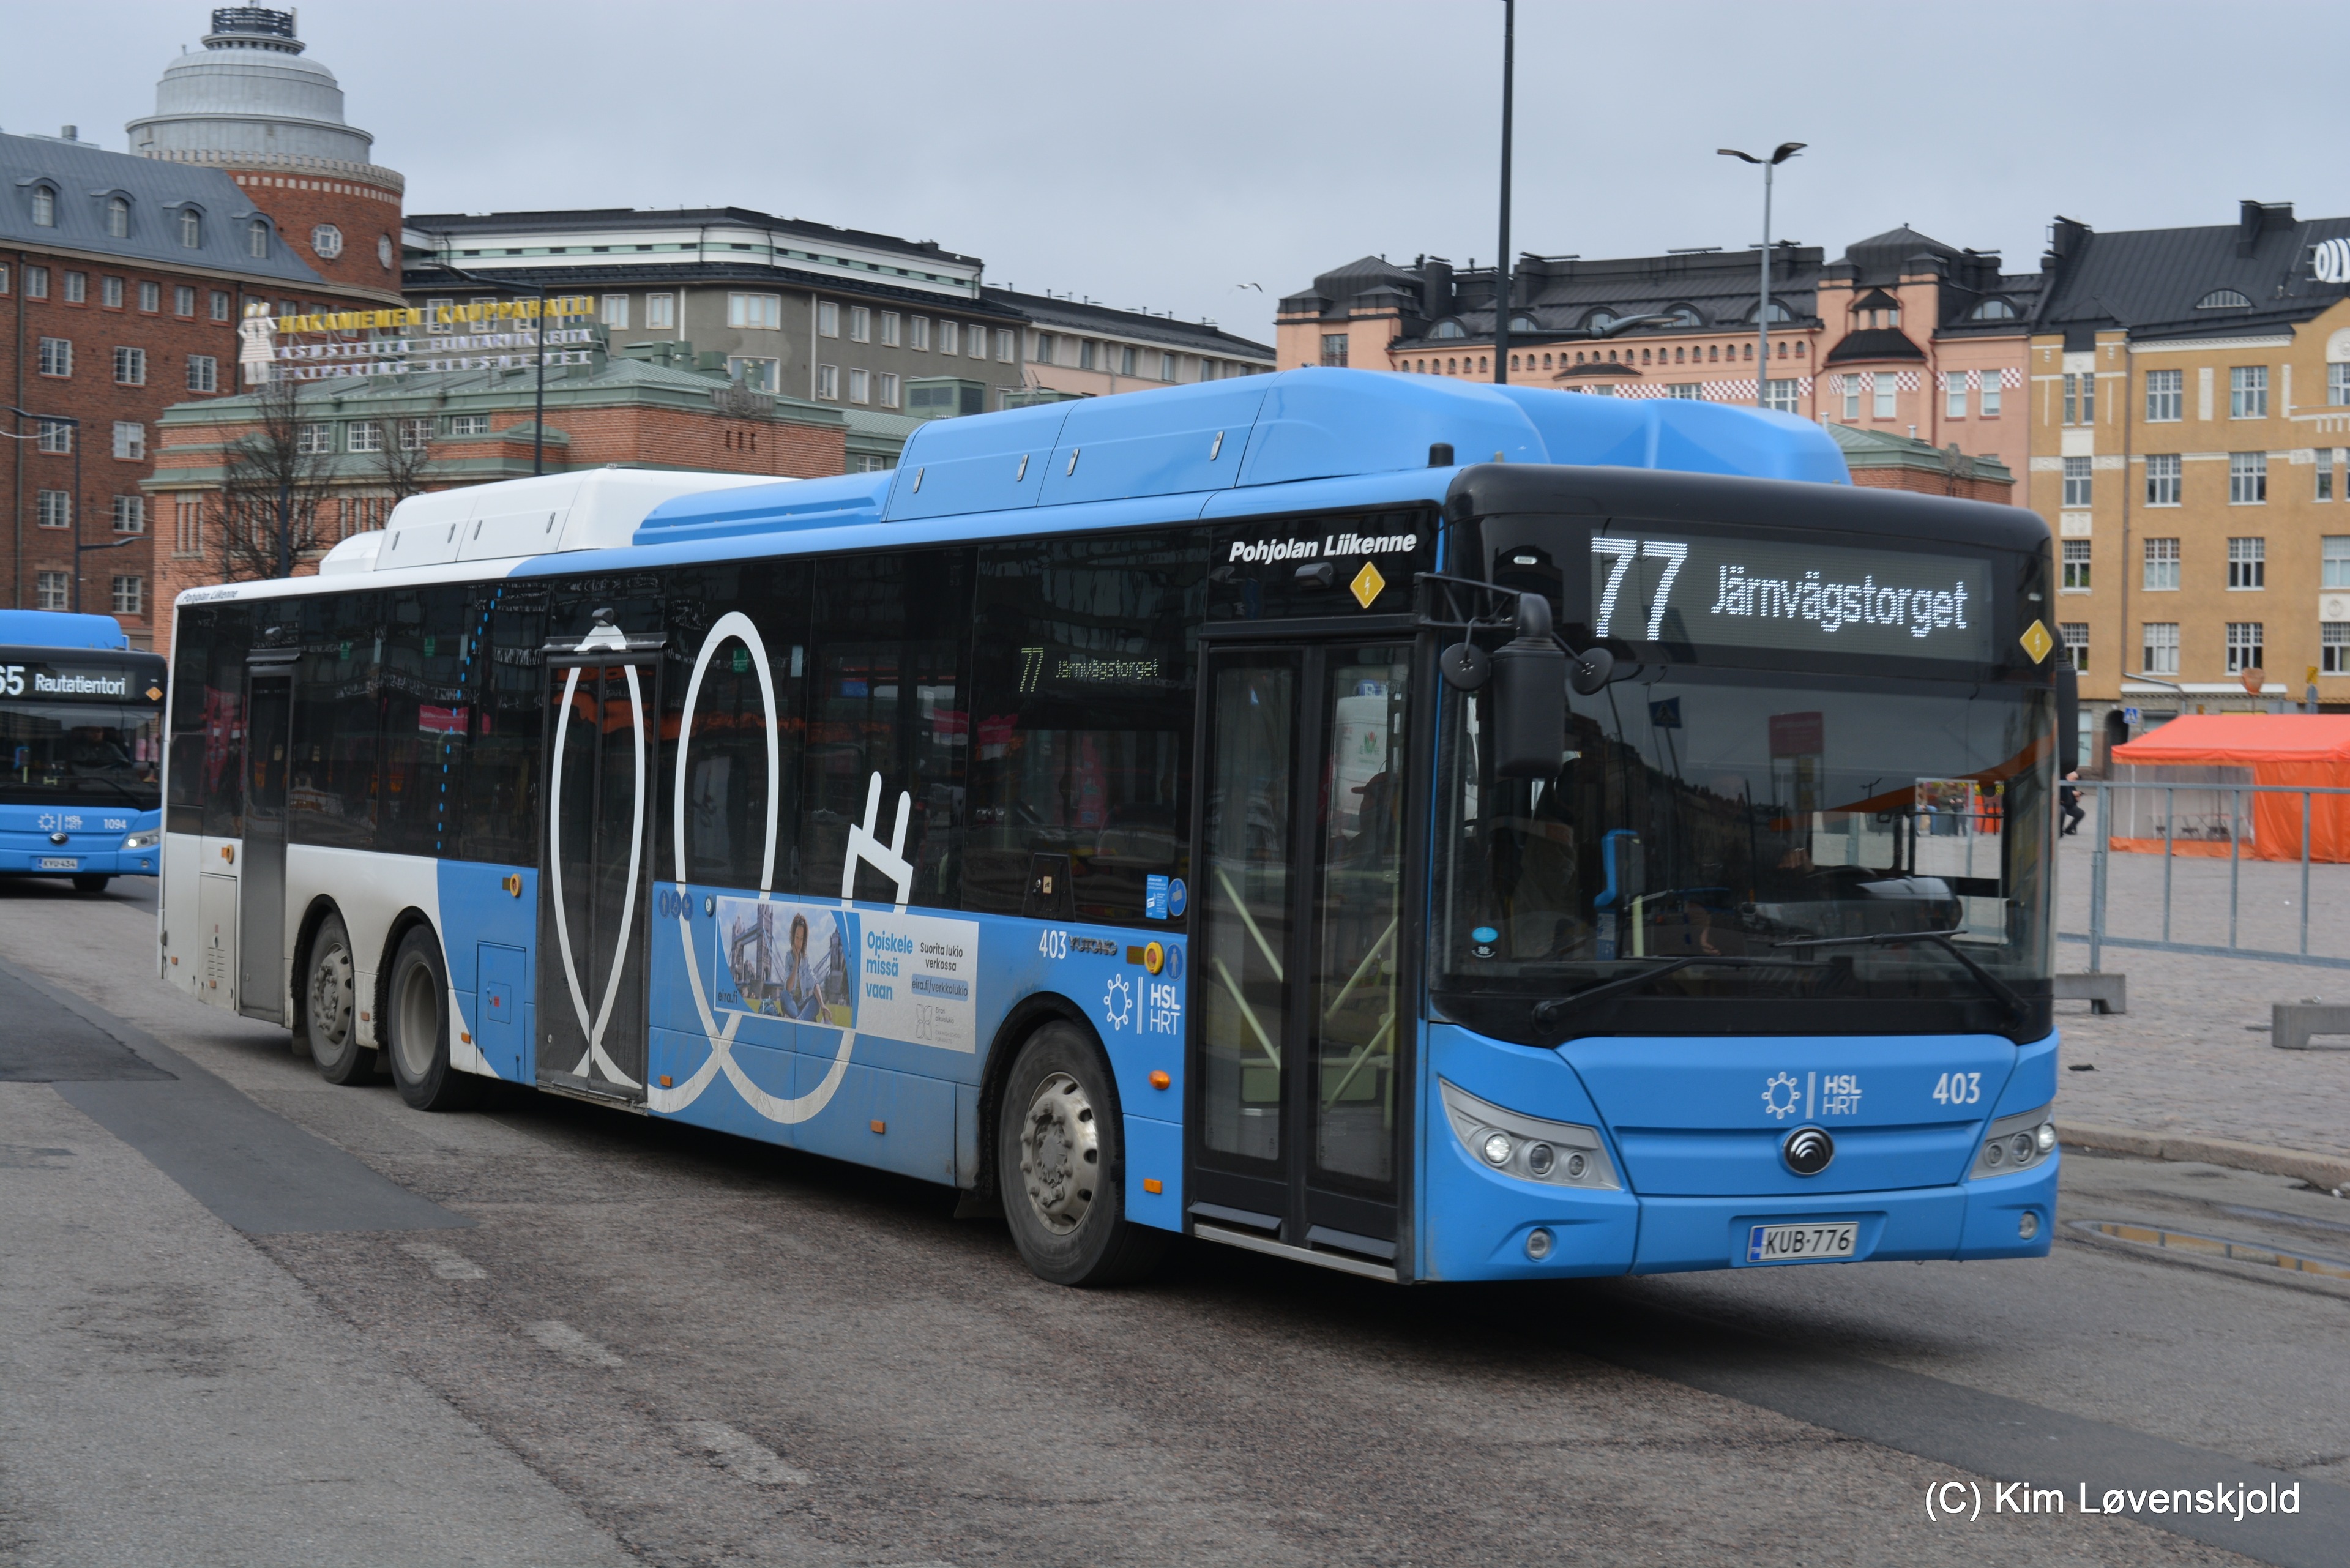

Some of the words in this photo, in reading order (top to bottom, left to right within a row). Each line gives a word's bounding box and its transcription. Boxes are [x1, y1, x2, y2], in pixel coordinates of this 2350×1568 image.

[280, 308, 421, 333] HAKANIEMEN
[437, 296, 594, 323] KAUPPAHALLI
[1229, 537, 1319, 564] Pohjolan
[1323, 533, 1417, 556] Liikenne
[1591, 537, 1688, 640] 77
[1711, 565, 1967, 637] Järnvägstorget
[1020, 647, 1043, 692] 77
[1056, 659, 1158, 679] Järnvägstorget
[35, 673, 125, 695] Rautatientori
[103, 819, 127, 829] 1094
[867, 930, 913, 956] Opiskele
[920, 942, 944, 955] Suorita
[946, 944, 963, 958] lukio
[1039, 929, 1067, 960] 403
[1069, 936, 1118, 955] YUTONG
[866, 954, 898, 977] missä
[925, 958, 957, 971] verkossa
[718, 989, 737, 1004] eira.fi
[866, 983, 893, 1001] vaan
[912, 978, 968, 996] eira.fi/verkkolukio
[1150, 983, 1181, 1010] HSL
[1150, 1009, 1181, 1036] HRT
[1824, 1075, 1862, 1094] HSL
[1932, 1072, 1982, 1105] 403
[1822, 1096, 1862, 1115] HRT
[1765, 1228, 1851, 1255] KUB-776
